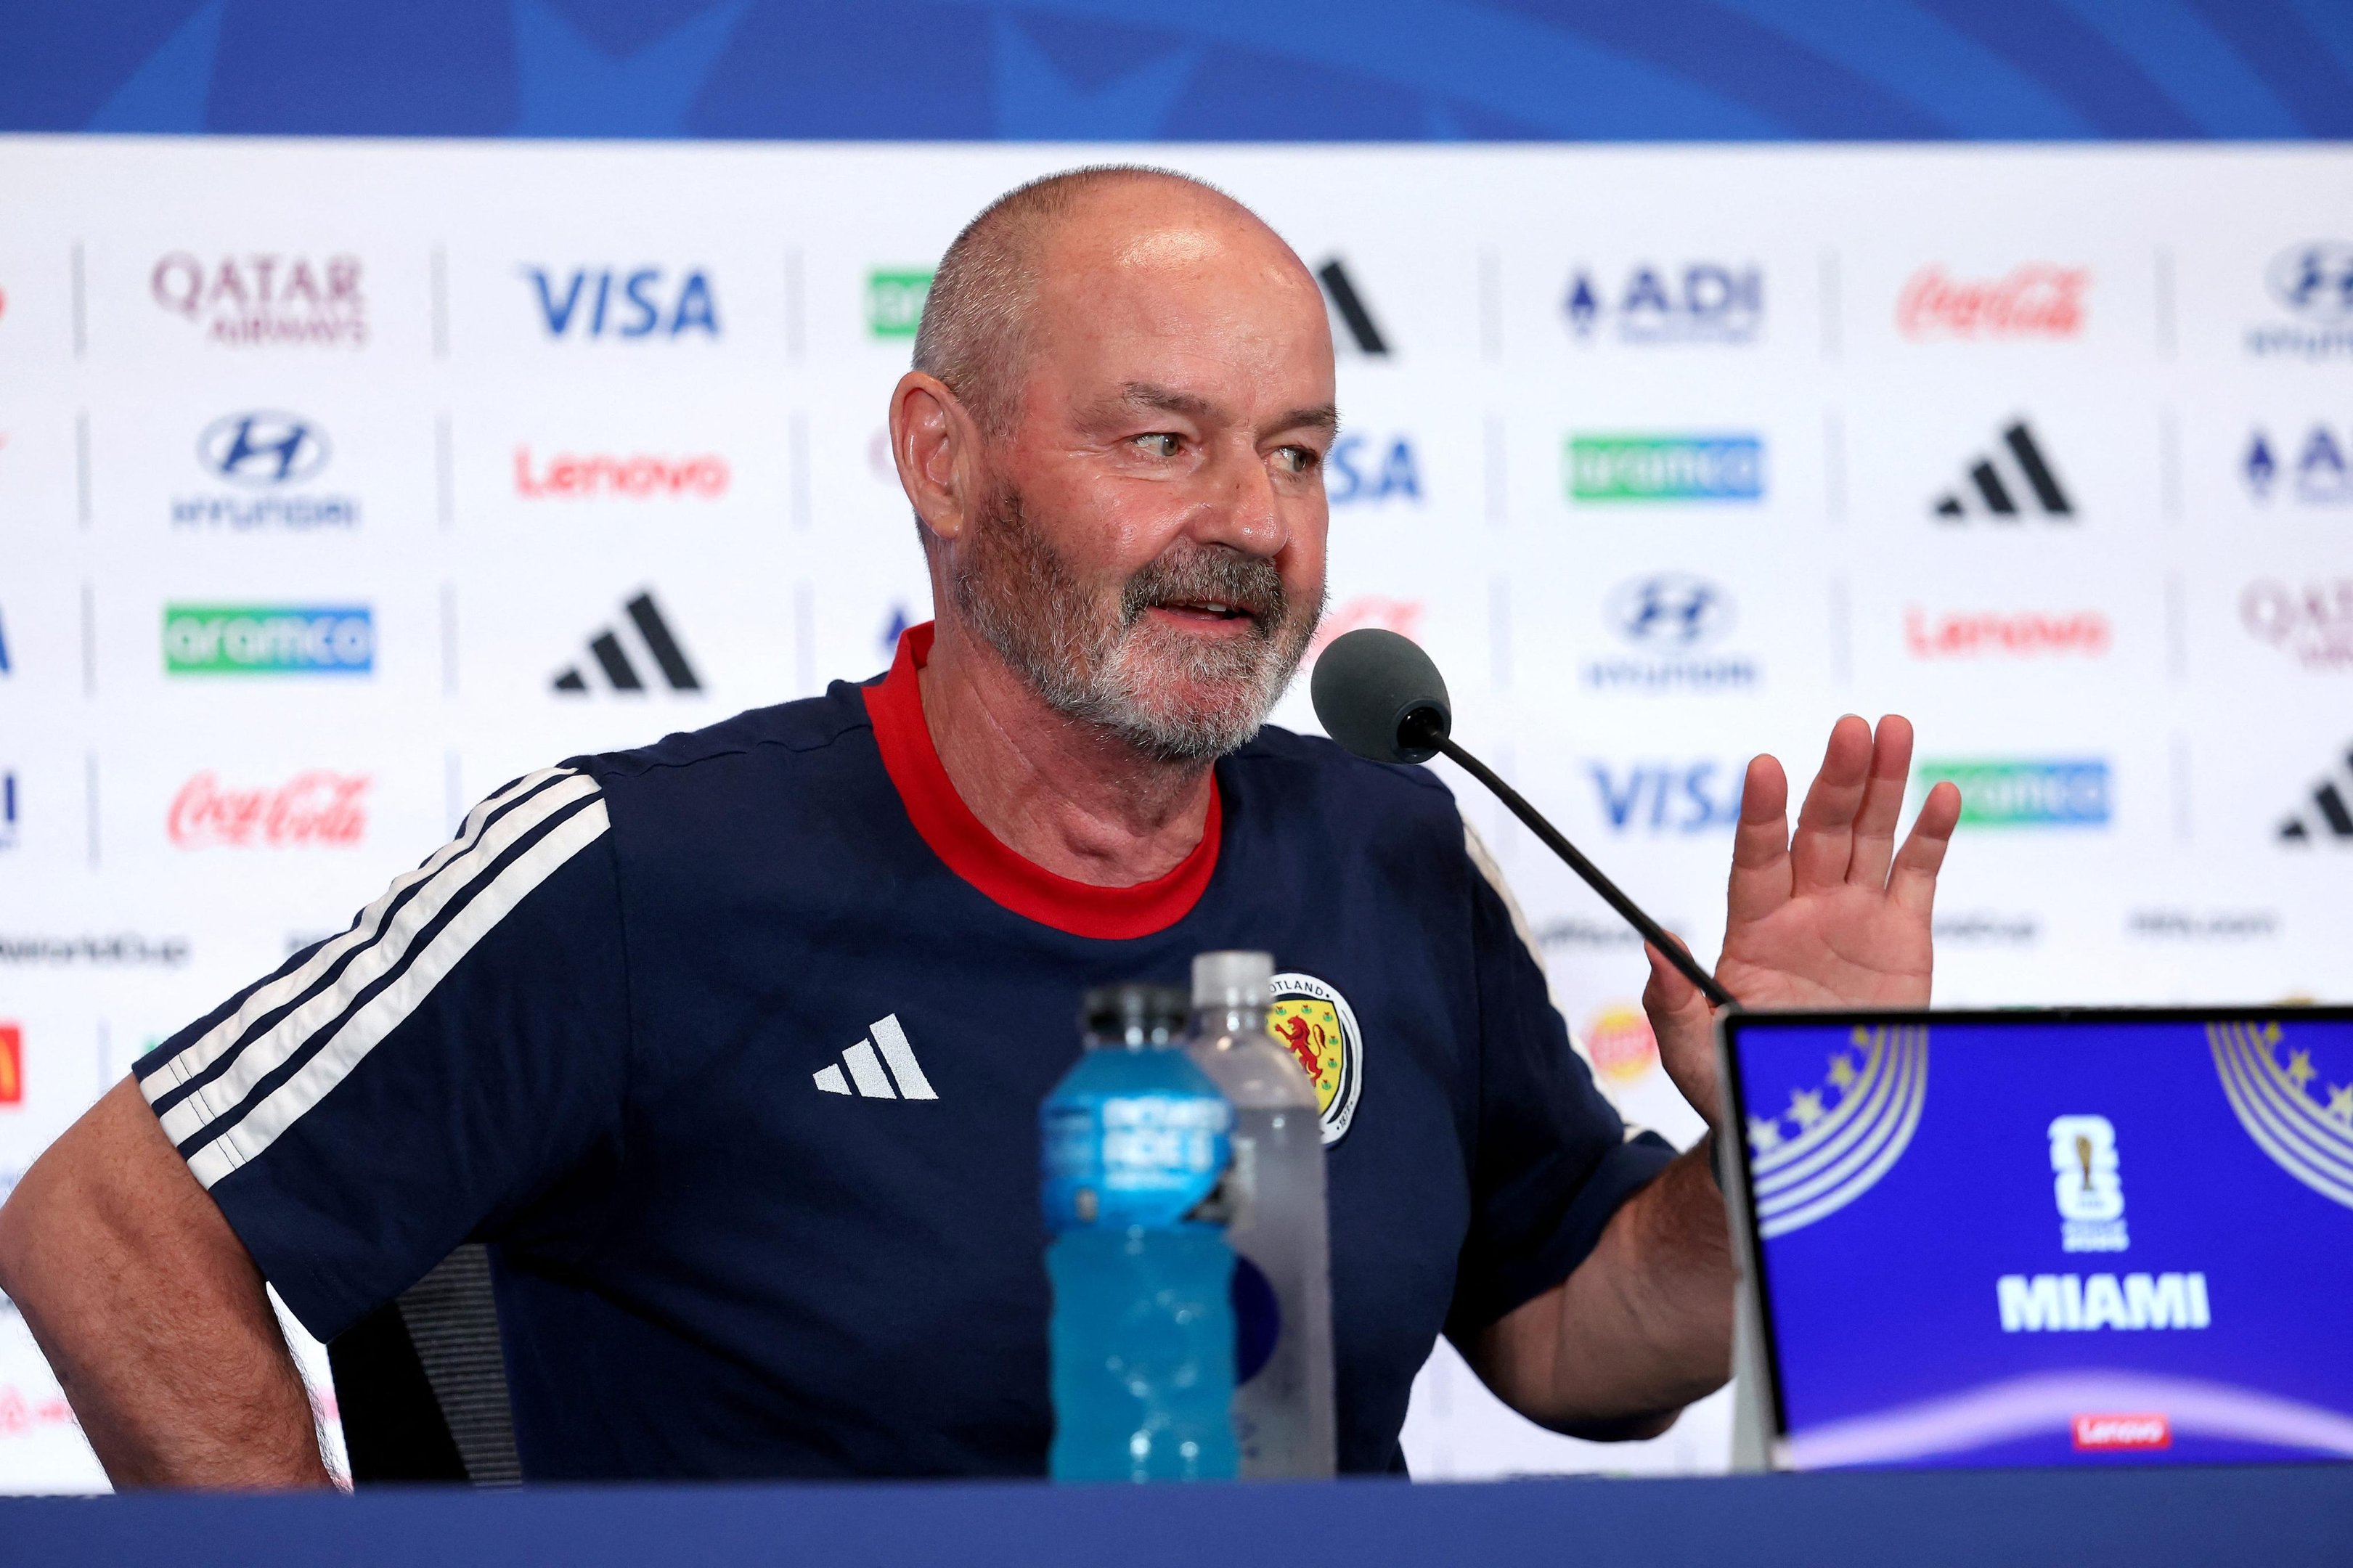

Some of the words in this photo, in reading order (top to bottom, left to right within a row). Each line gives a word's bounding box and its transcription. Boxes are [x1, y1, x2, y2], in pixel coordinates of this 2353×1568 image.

[150, 252, 365, 321] QATAR
[522, 266, 721, 340] VISA
[1619, 263, 1763, 315] ADI
[514, 446, 730, 499] Lenovo
[1330, 436, 1423, 506] SA
[166, 616, 372, 665] aramco
[1587, 762, 1744, 833] VIS
[1268, 981, 1324, 996] OTLAND
[1997, 1273, 2210, 1332] MIAMI
